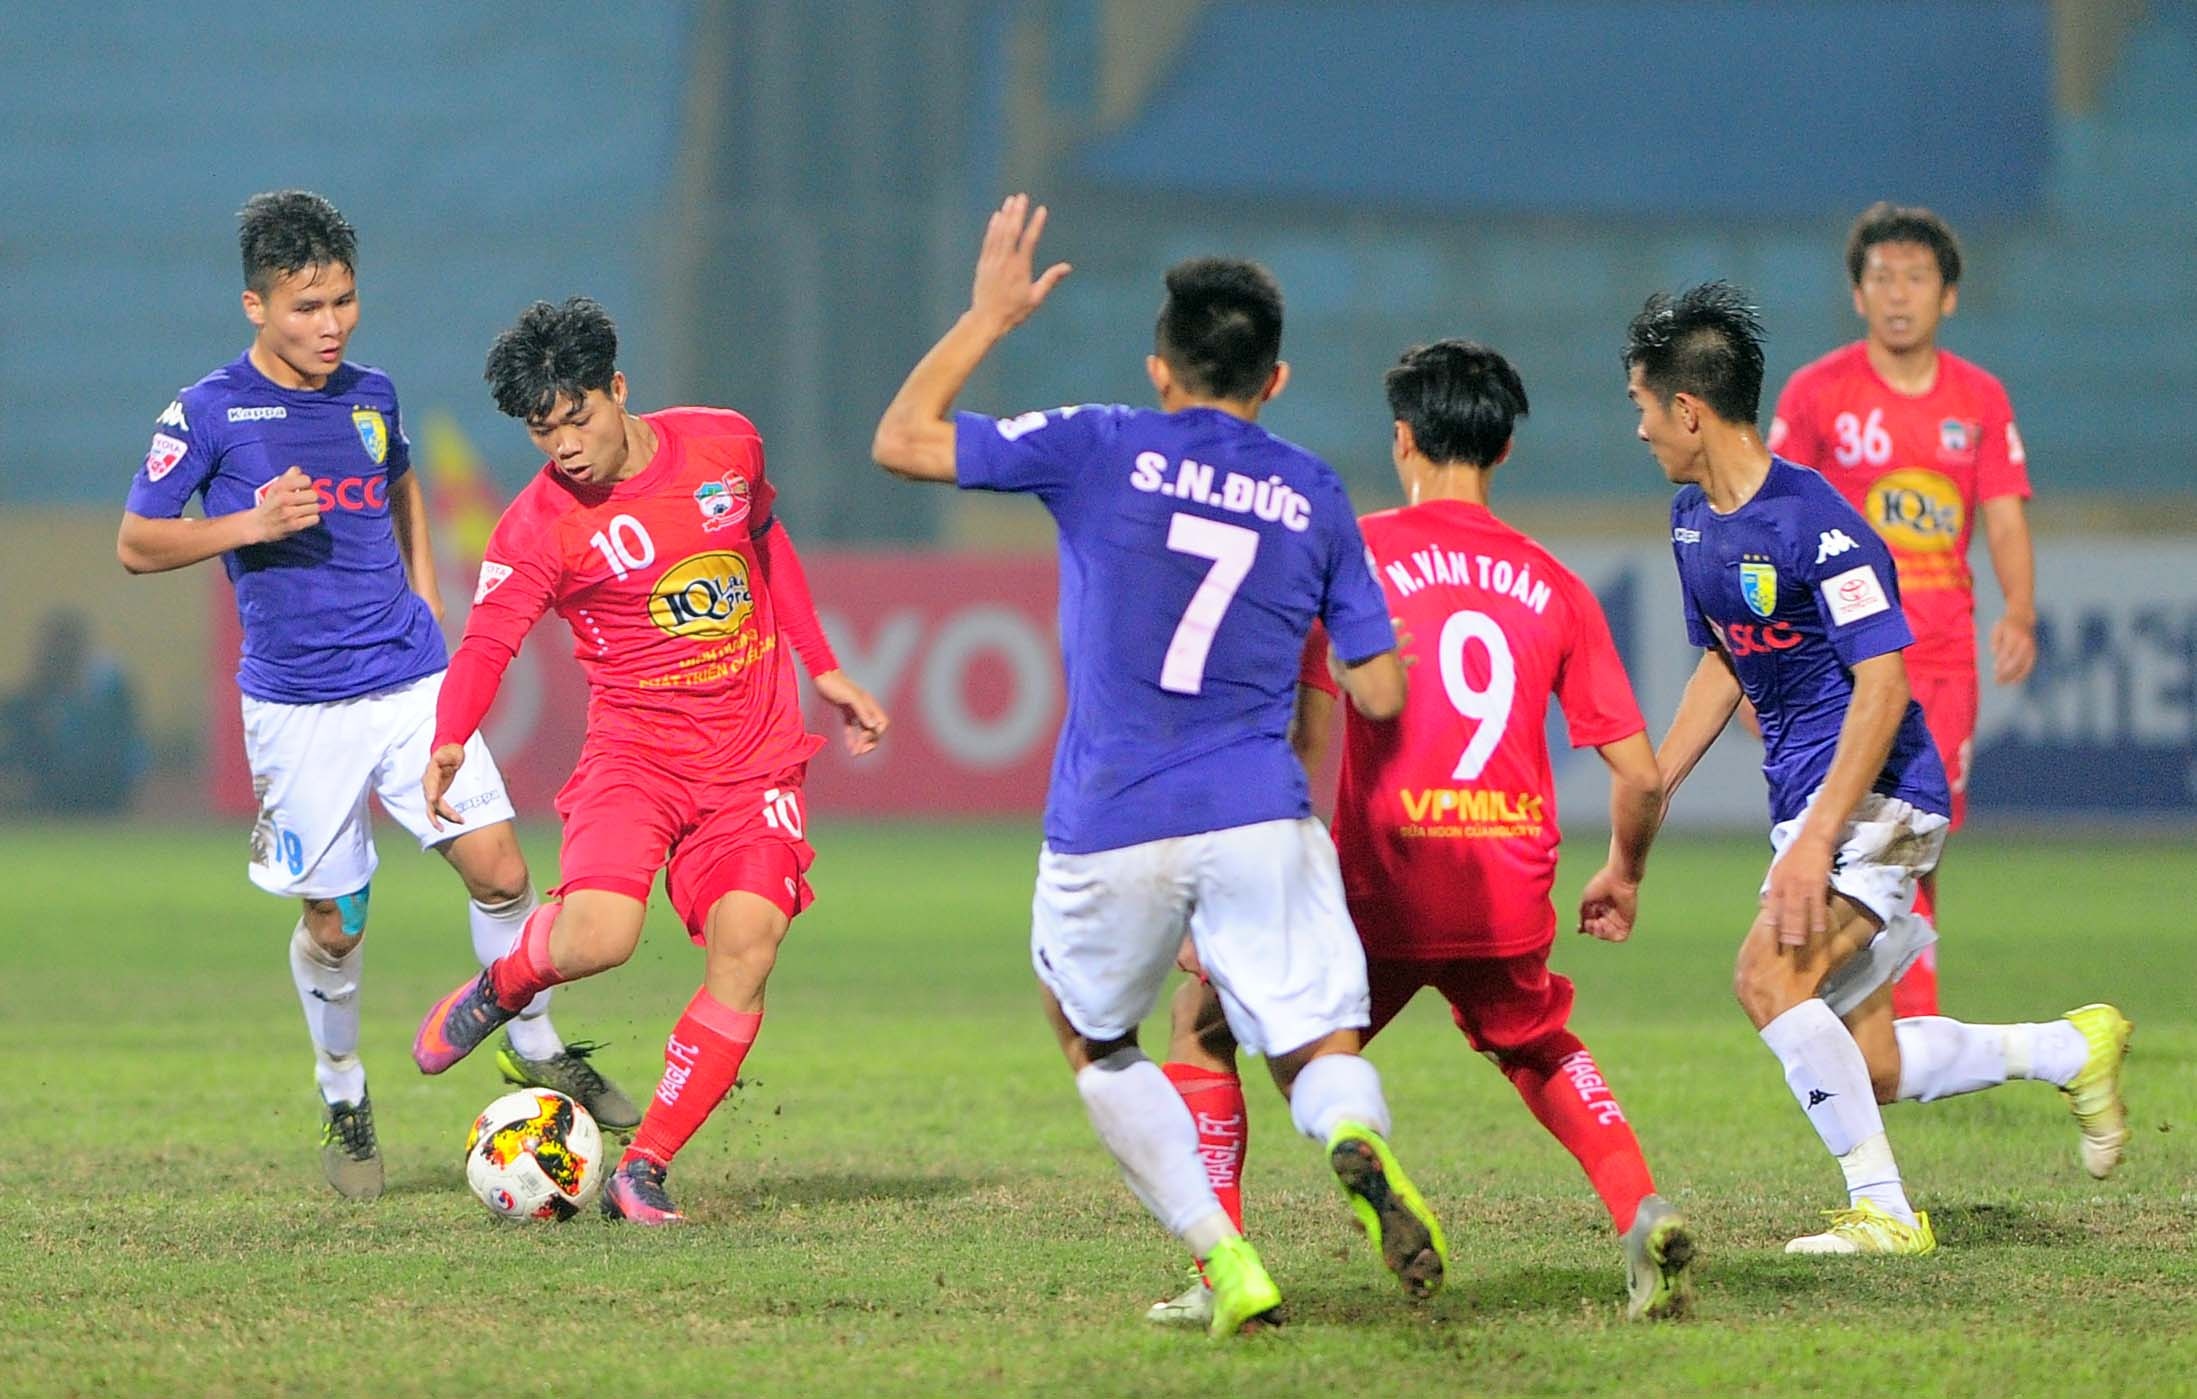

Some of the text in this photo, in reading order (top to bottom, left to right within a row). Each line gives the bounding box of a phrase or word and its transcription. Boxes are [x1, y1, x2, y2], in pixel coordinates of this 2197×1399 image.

[1834, 408, 1892, 466] 36
[589, 514, 656, 582] 10
[1160, 512, 1260, 695] 7
[1439, 610, 1517, 781] 9
[762, 787, 803, 840] 10
[1401, 788, 1544, 823] VPMILK
[656, 1033, 699, 1106] HAGL FC
[1559, 1050, 1626, 1125] HAGL FC
[1196, 1112, 1240, 1188] HAGL FC
